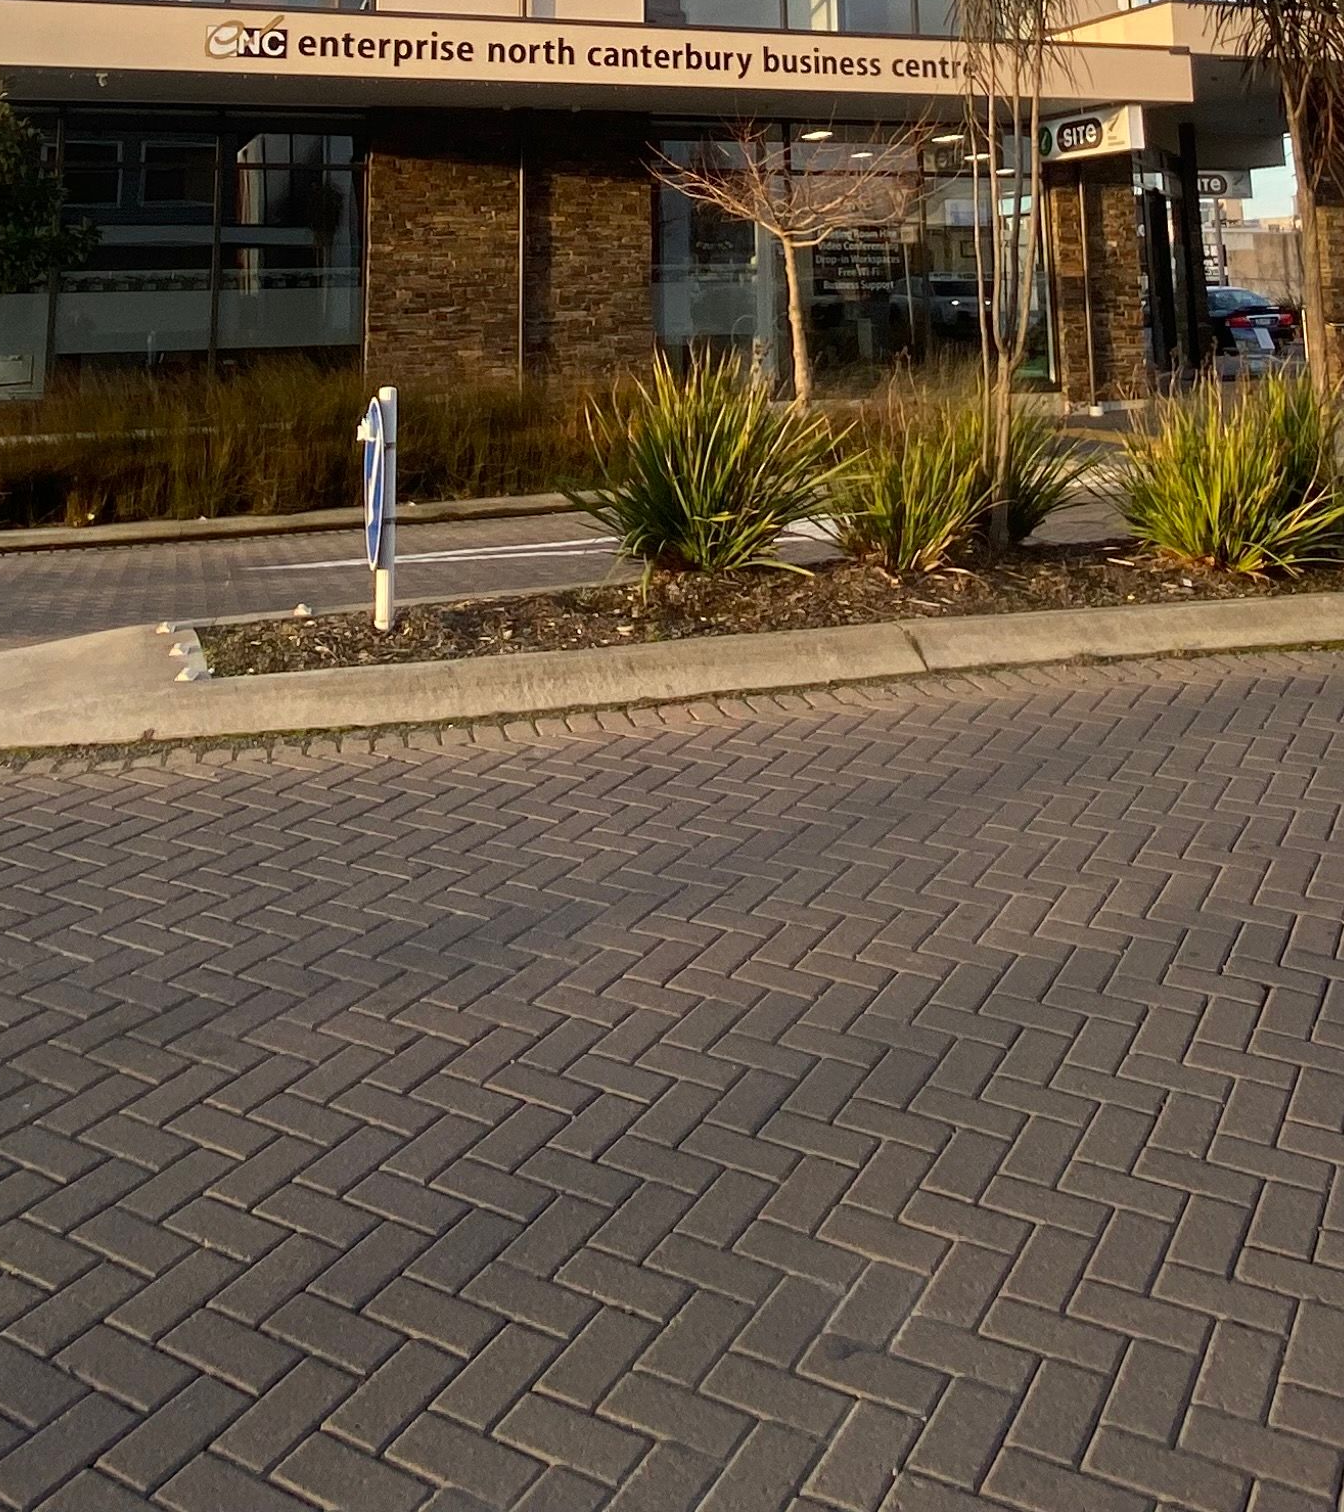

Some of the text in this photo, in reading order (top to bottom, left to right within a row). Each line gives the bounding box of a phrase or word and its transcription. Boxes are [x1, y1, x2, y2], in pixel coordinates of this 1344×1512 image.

[298, 31, 474, 66] enterprise
[487, 38, 575, 65] north
[587, 43, 752, 79] canterbury
[763, 46, 881, 77] business
[818, 241, 842, 251] Video
[860, 280, 894, 291] Support
